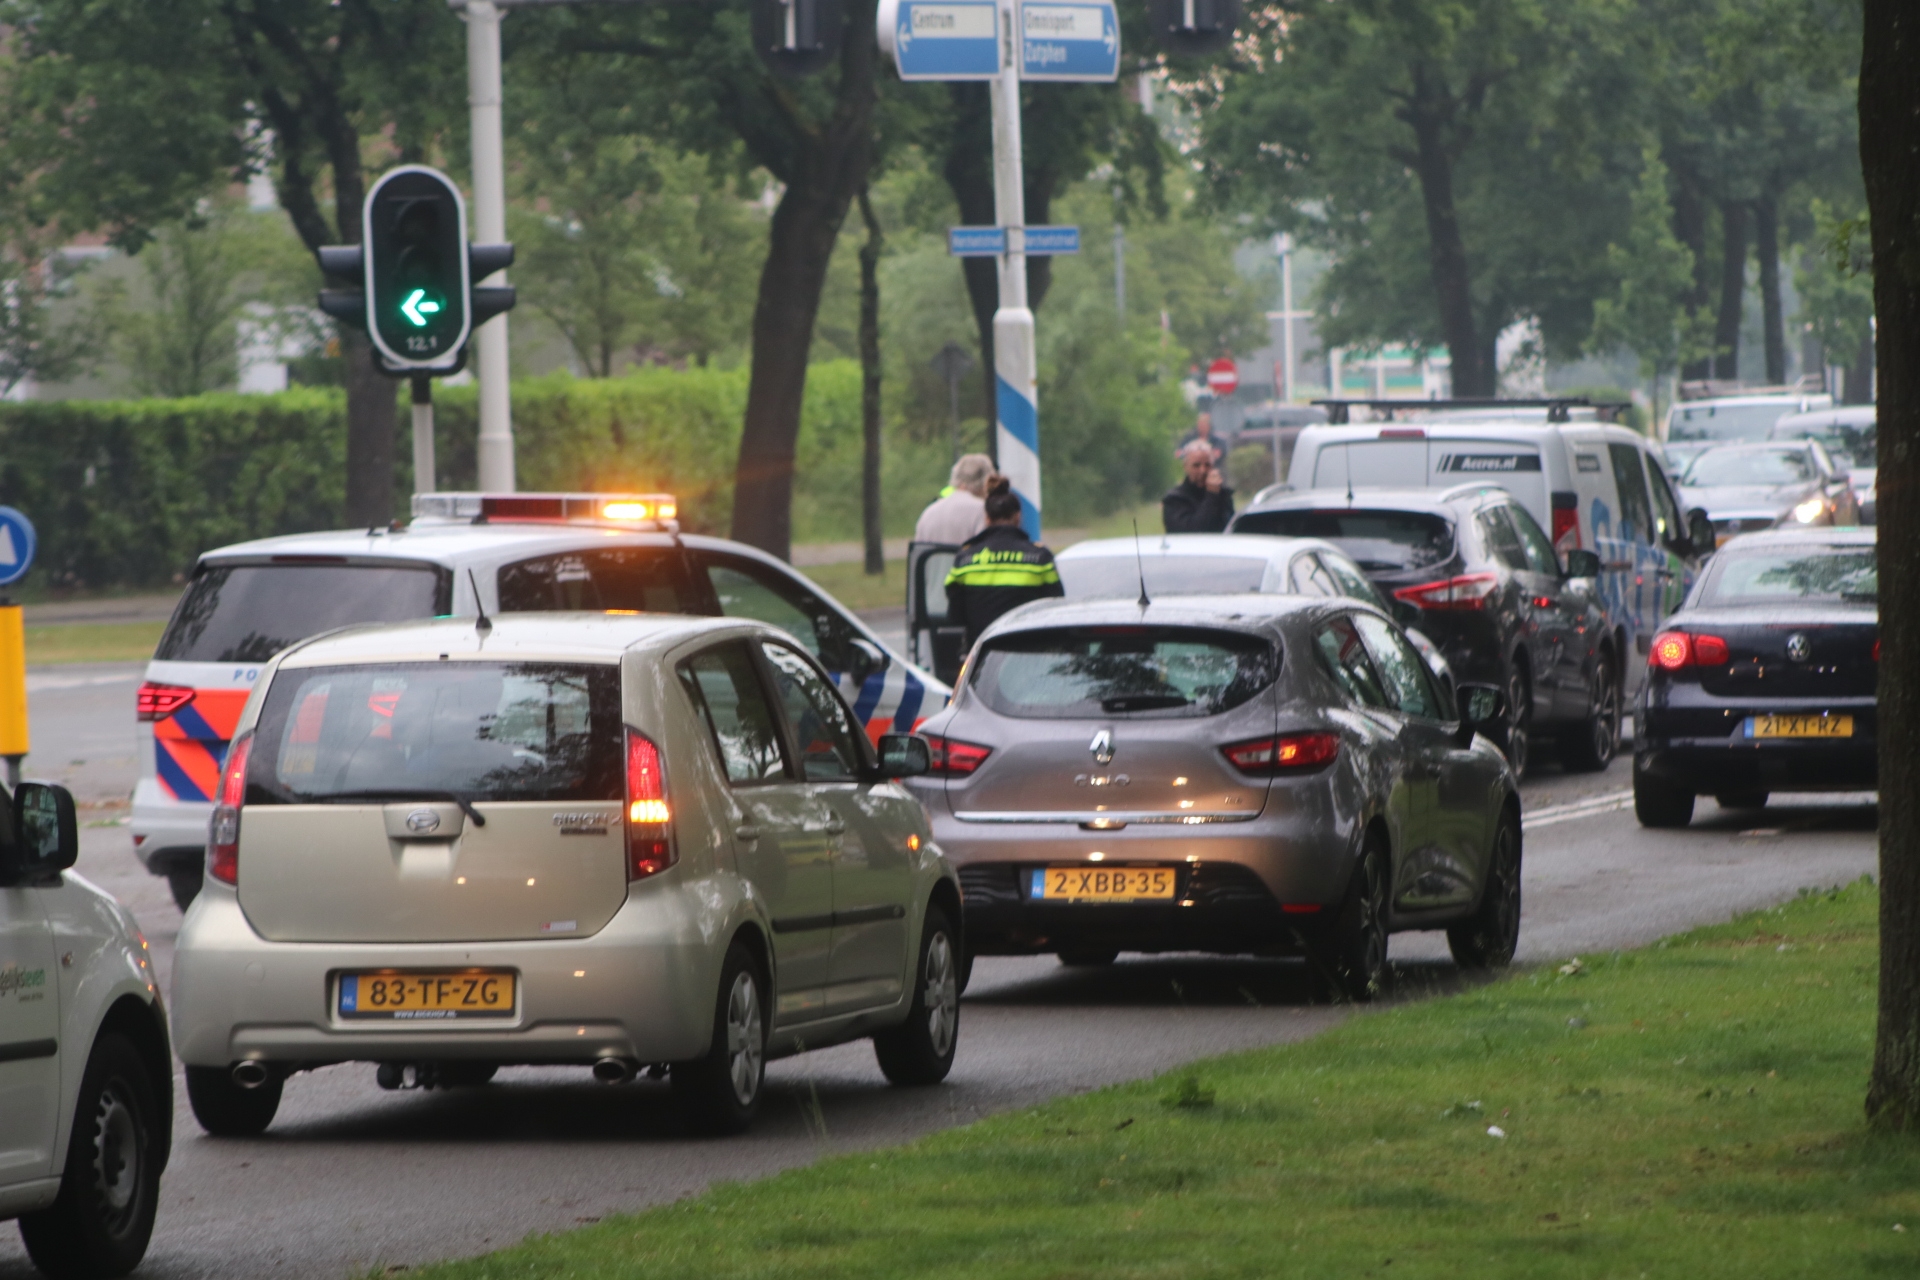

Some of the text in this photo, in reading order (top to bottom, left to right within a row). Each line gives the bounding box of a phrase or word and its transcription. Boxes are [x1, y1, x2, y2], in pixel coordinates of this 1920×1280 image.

[912, 10, 955, 29] Centrum
[1025, 12, 1076, 35] Omnisport
[1025, 41, 1067, 67] Zutphen
[406, 336, 438, 351] 12.1
[1461, 457, 1518, 471] Accres.nl
[1763, 717, 1841, 734] 21-XT-RZ
[1053, 872, 1166, 894] 2-XBB-35
[370, 978, 499, 1006] 83-TF-ZG
